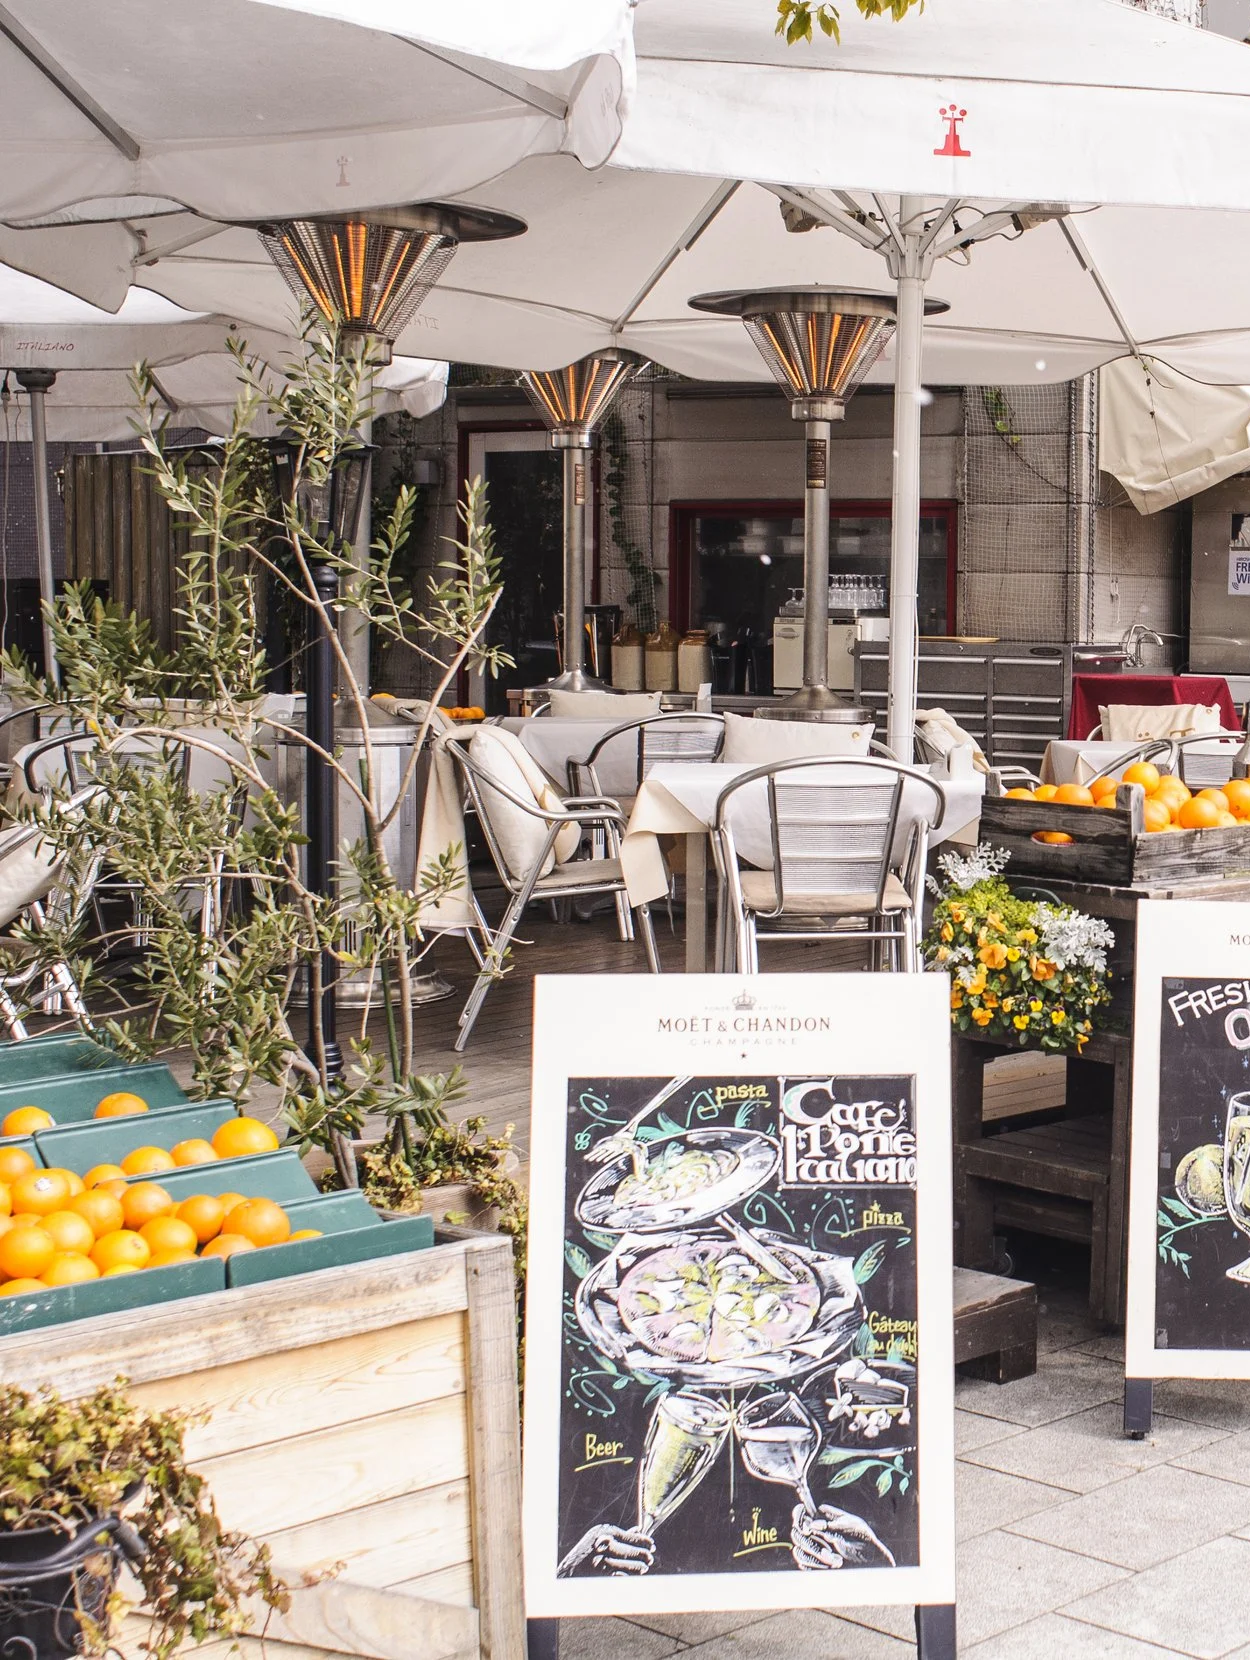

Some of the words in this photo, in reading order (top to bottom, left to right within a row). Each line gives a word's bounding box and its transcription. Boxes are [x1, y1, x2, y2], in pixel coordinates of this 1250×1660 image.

[16, 341, 75, 351] ITALIANO
[657, 1015, 713, 1033] MOËT
[717, 1020, 728, 1033] &
[733, 1017, 831, 1032] CHANDON
[690, 1038, 798, 1046] CHAMPAGNE
[715, 1084, 769, 1107] pasta
[797, 1122, 916, 1158] Ponte
[863, 1201, 904, 1229] pizza
[585, 1434, 624, 1460] Beer
